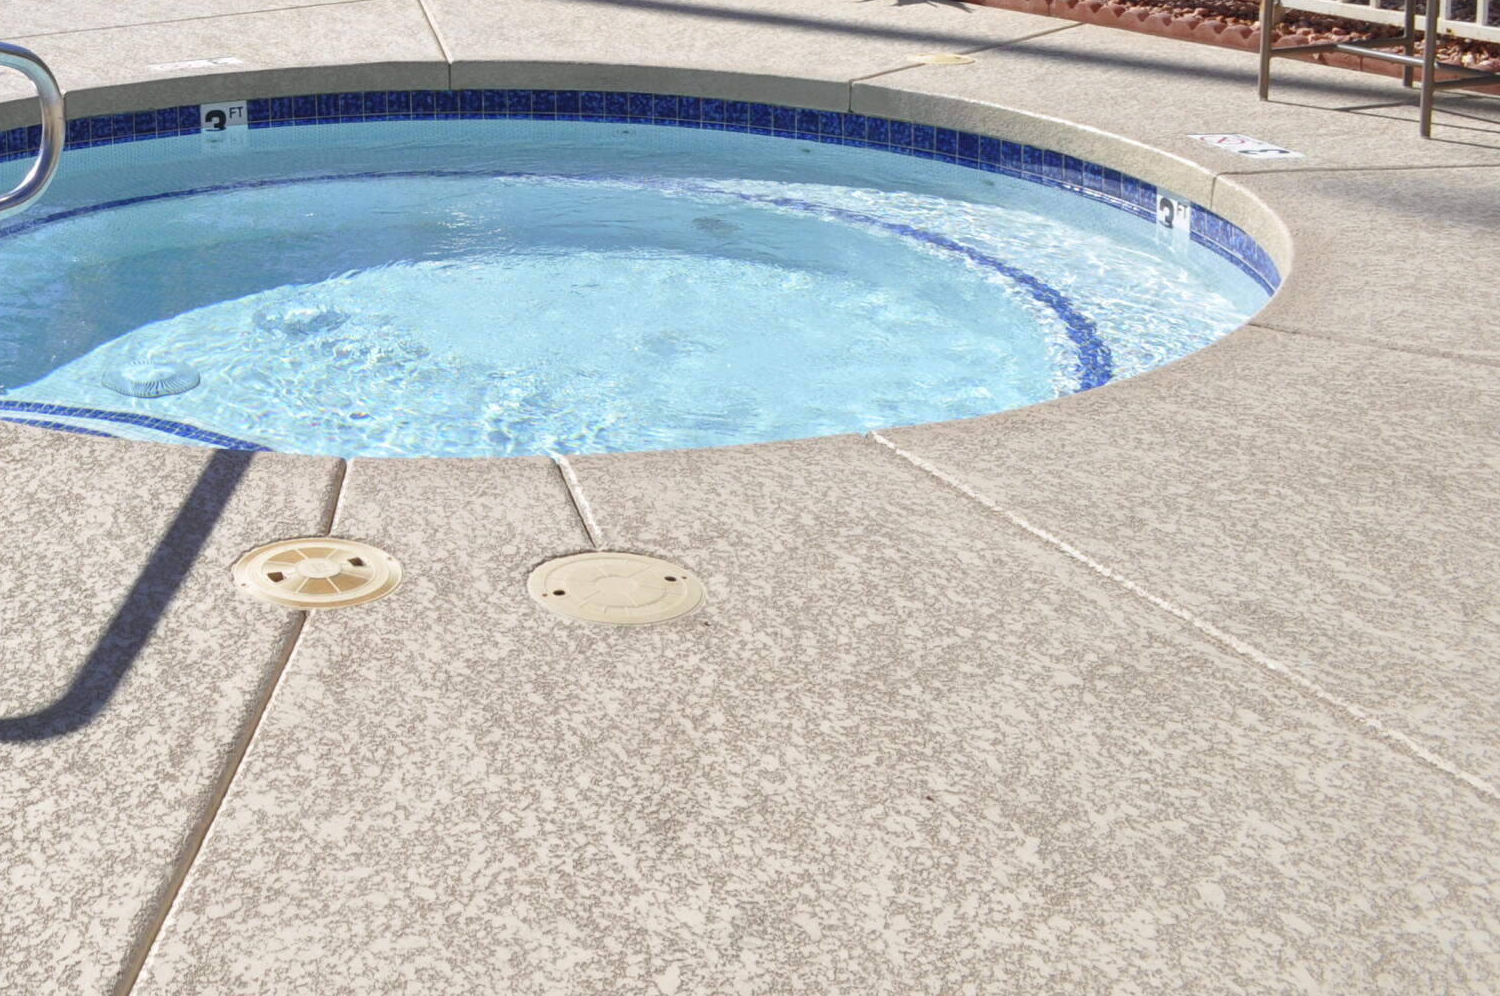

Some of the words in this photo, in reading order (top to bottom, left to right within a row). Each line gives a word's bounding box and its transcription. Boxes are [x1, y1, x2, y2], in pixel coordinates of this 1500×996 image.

[205, 109, 227, 131] 3
[228, 106, 244, 119] FT
[1176, 202, 1188, 219] FT
